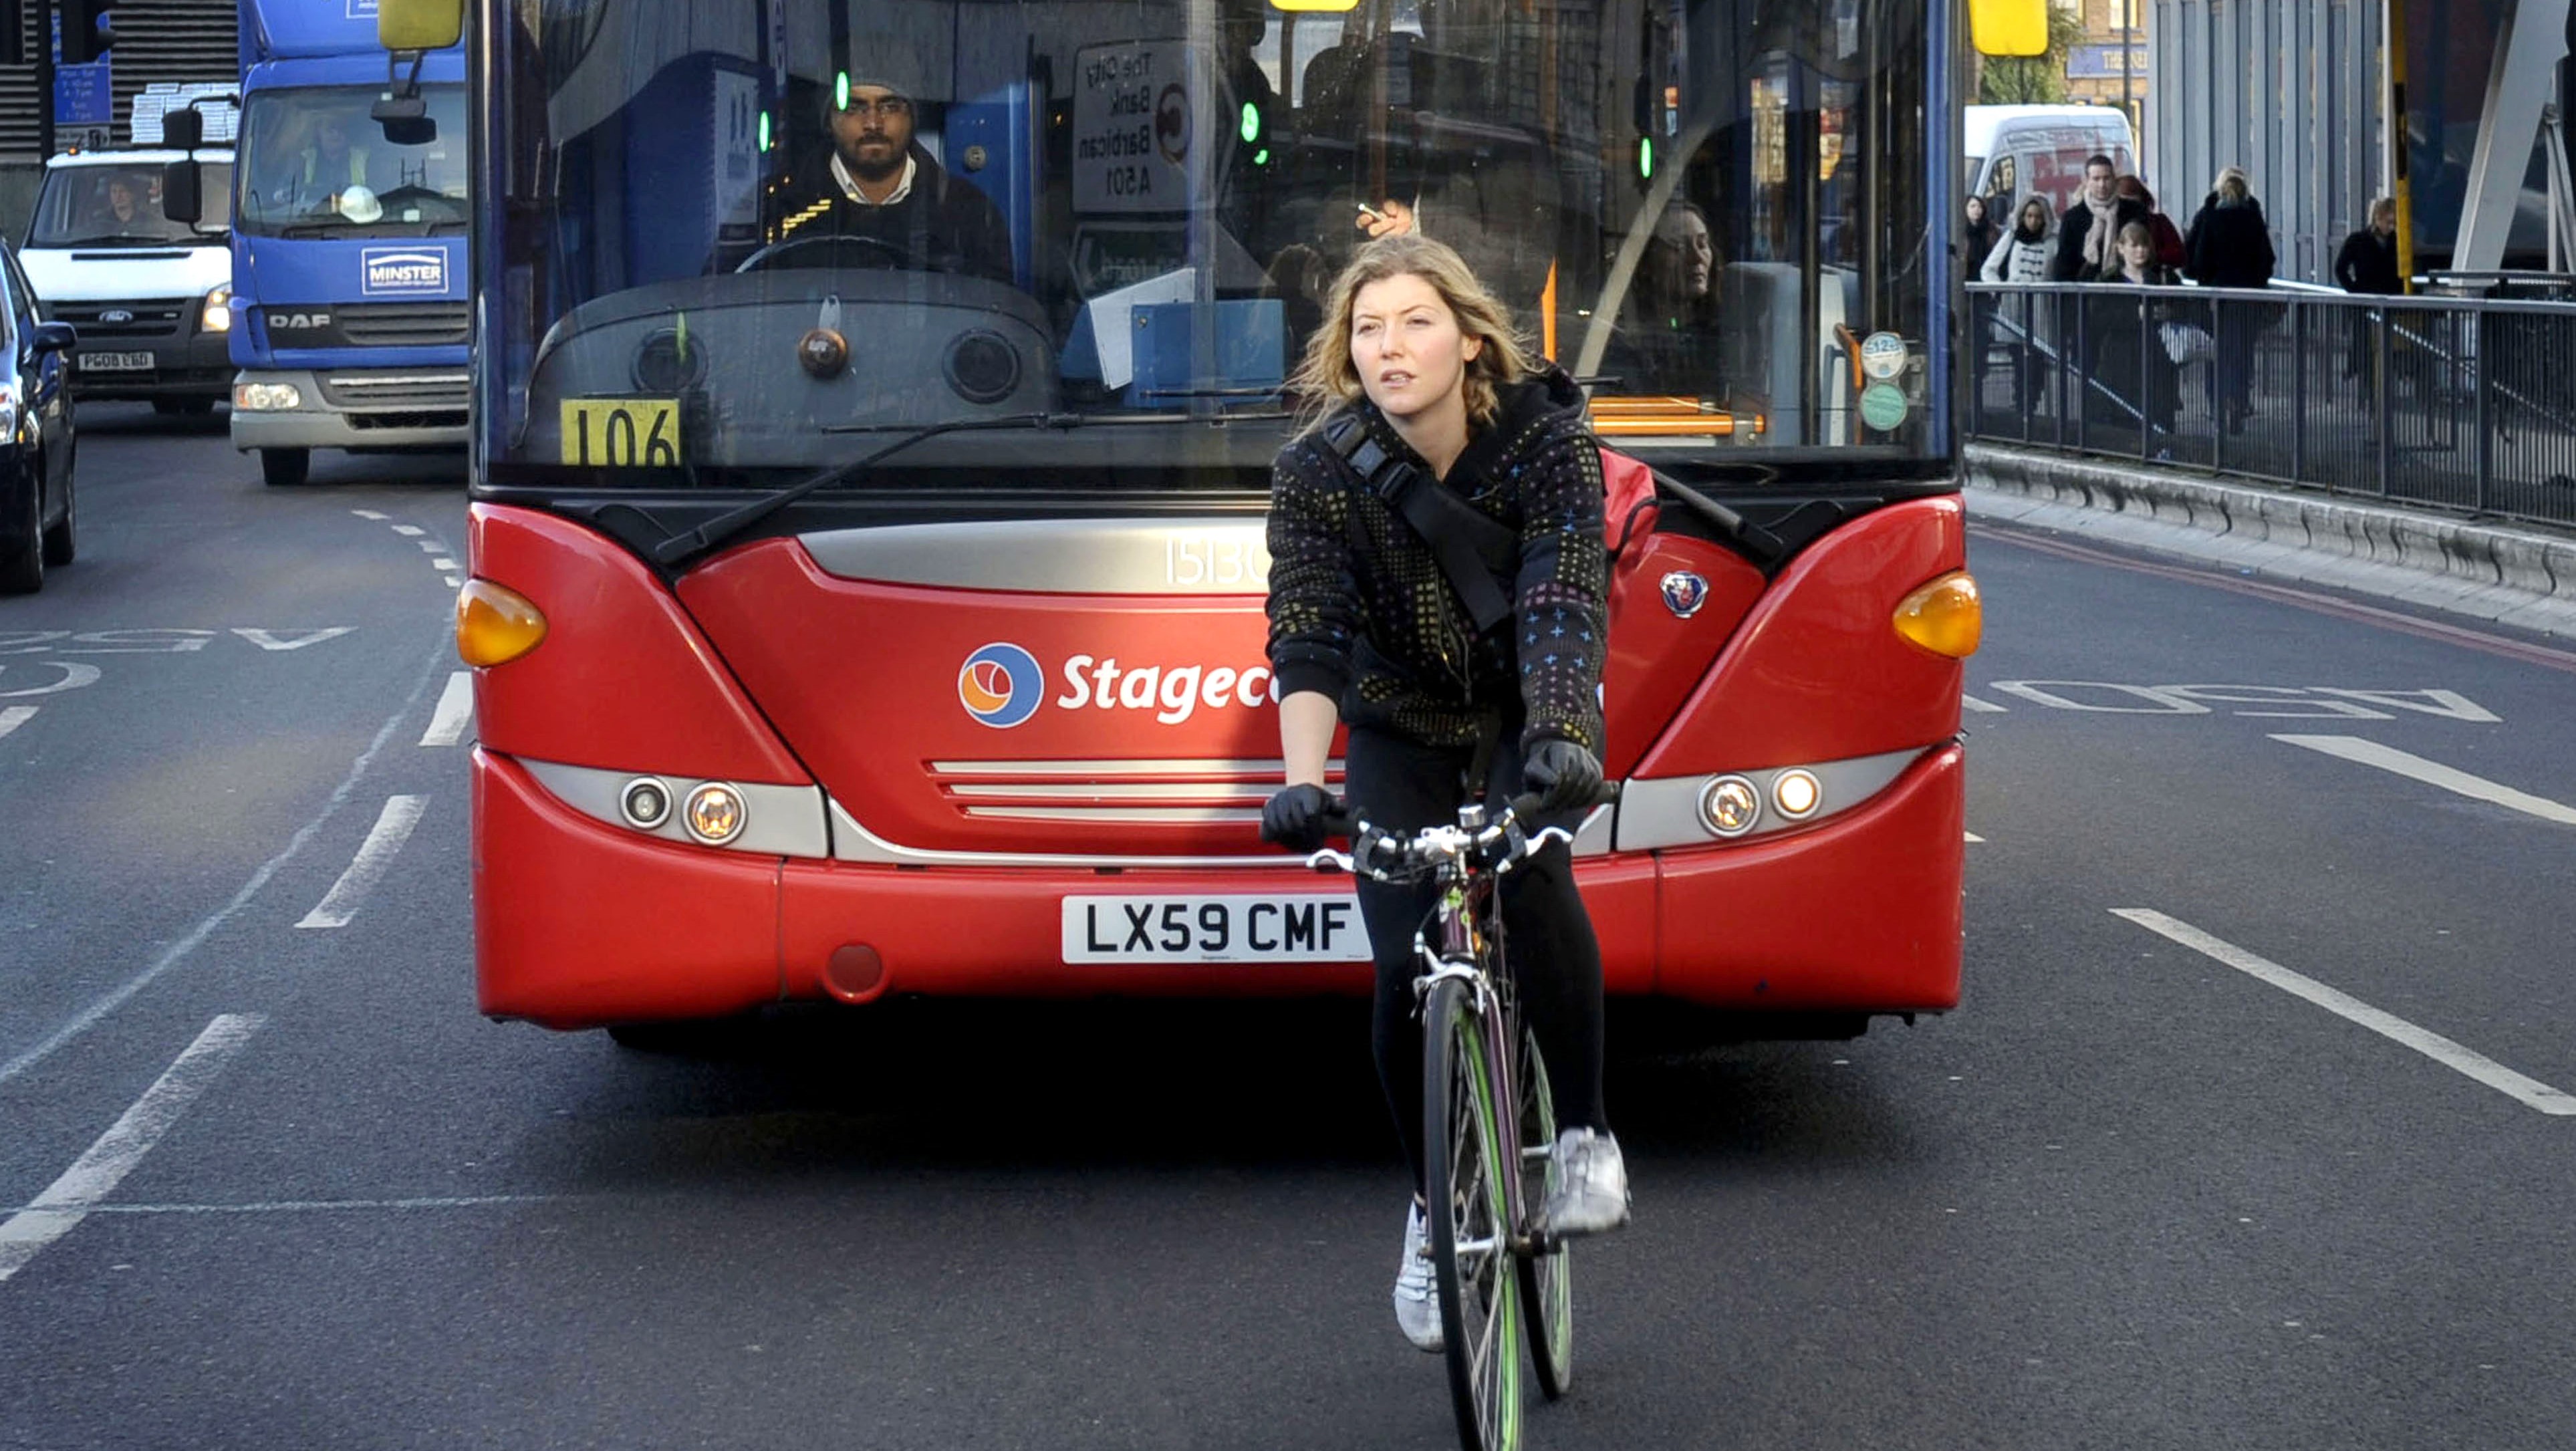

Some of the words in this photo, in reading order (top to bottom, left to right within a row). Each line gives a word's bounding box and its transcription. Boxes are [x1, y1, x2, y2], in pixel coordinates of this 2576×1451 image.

[370, 265, 440, 283] MINSTER
[269, 314, 330, 328] DAF
[578, 408, 674, 465] 106
[1087, 904, 1229, 952] LX59
[1248, 903, 1351, 952] CMF
